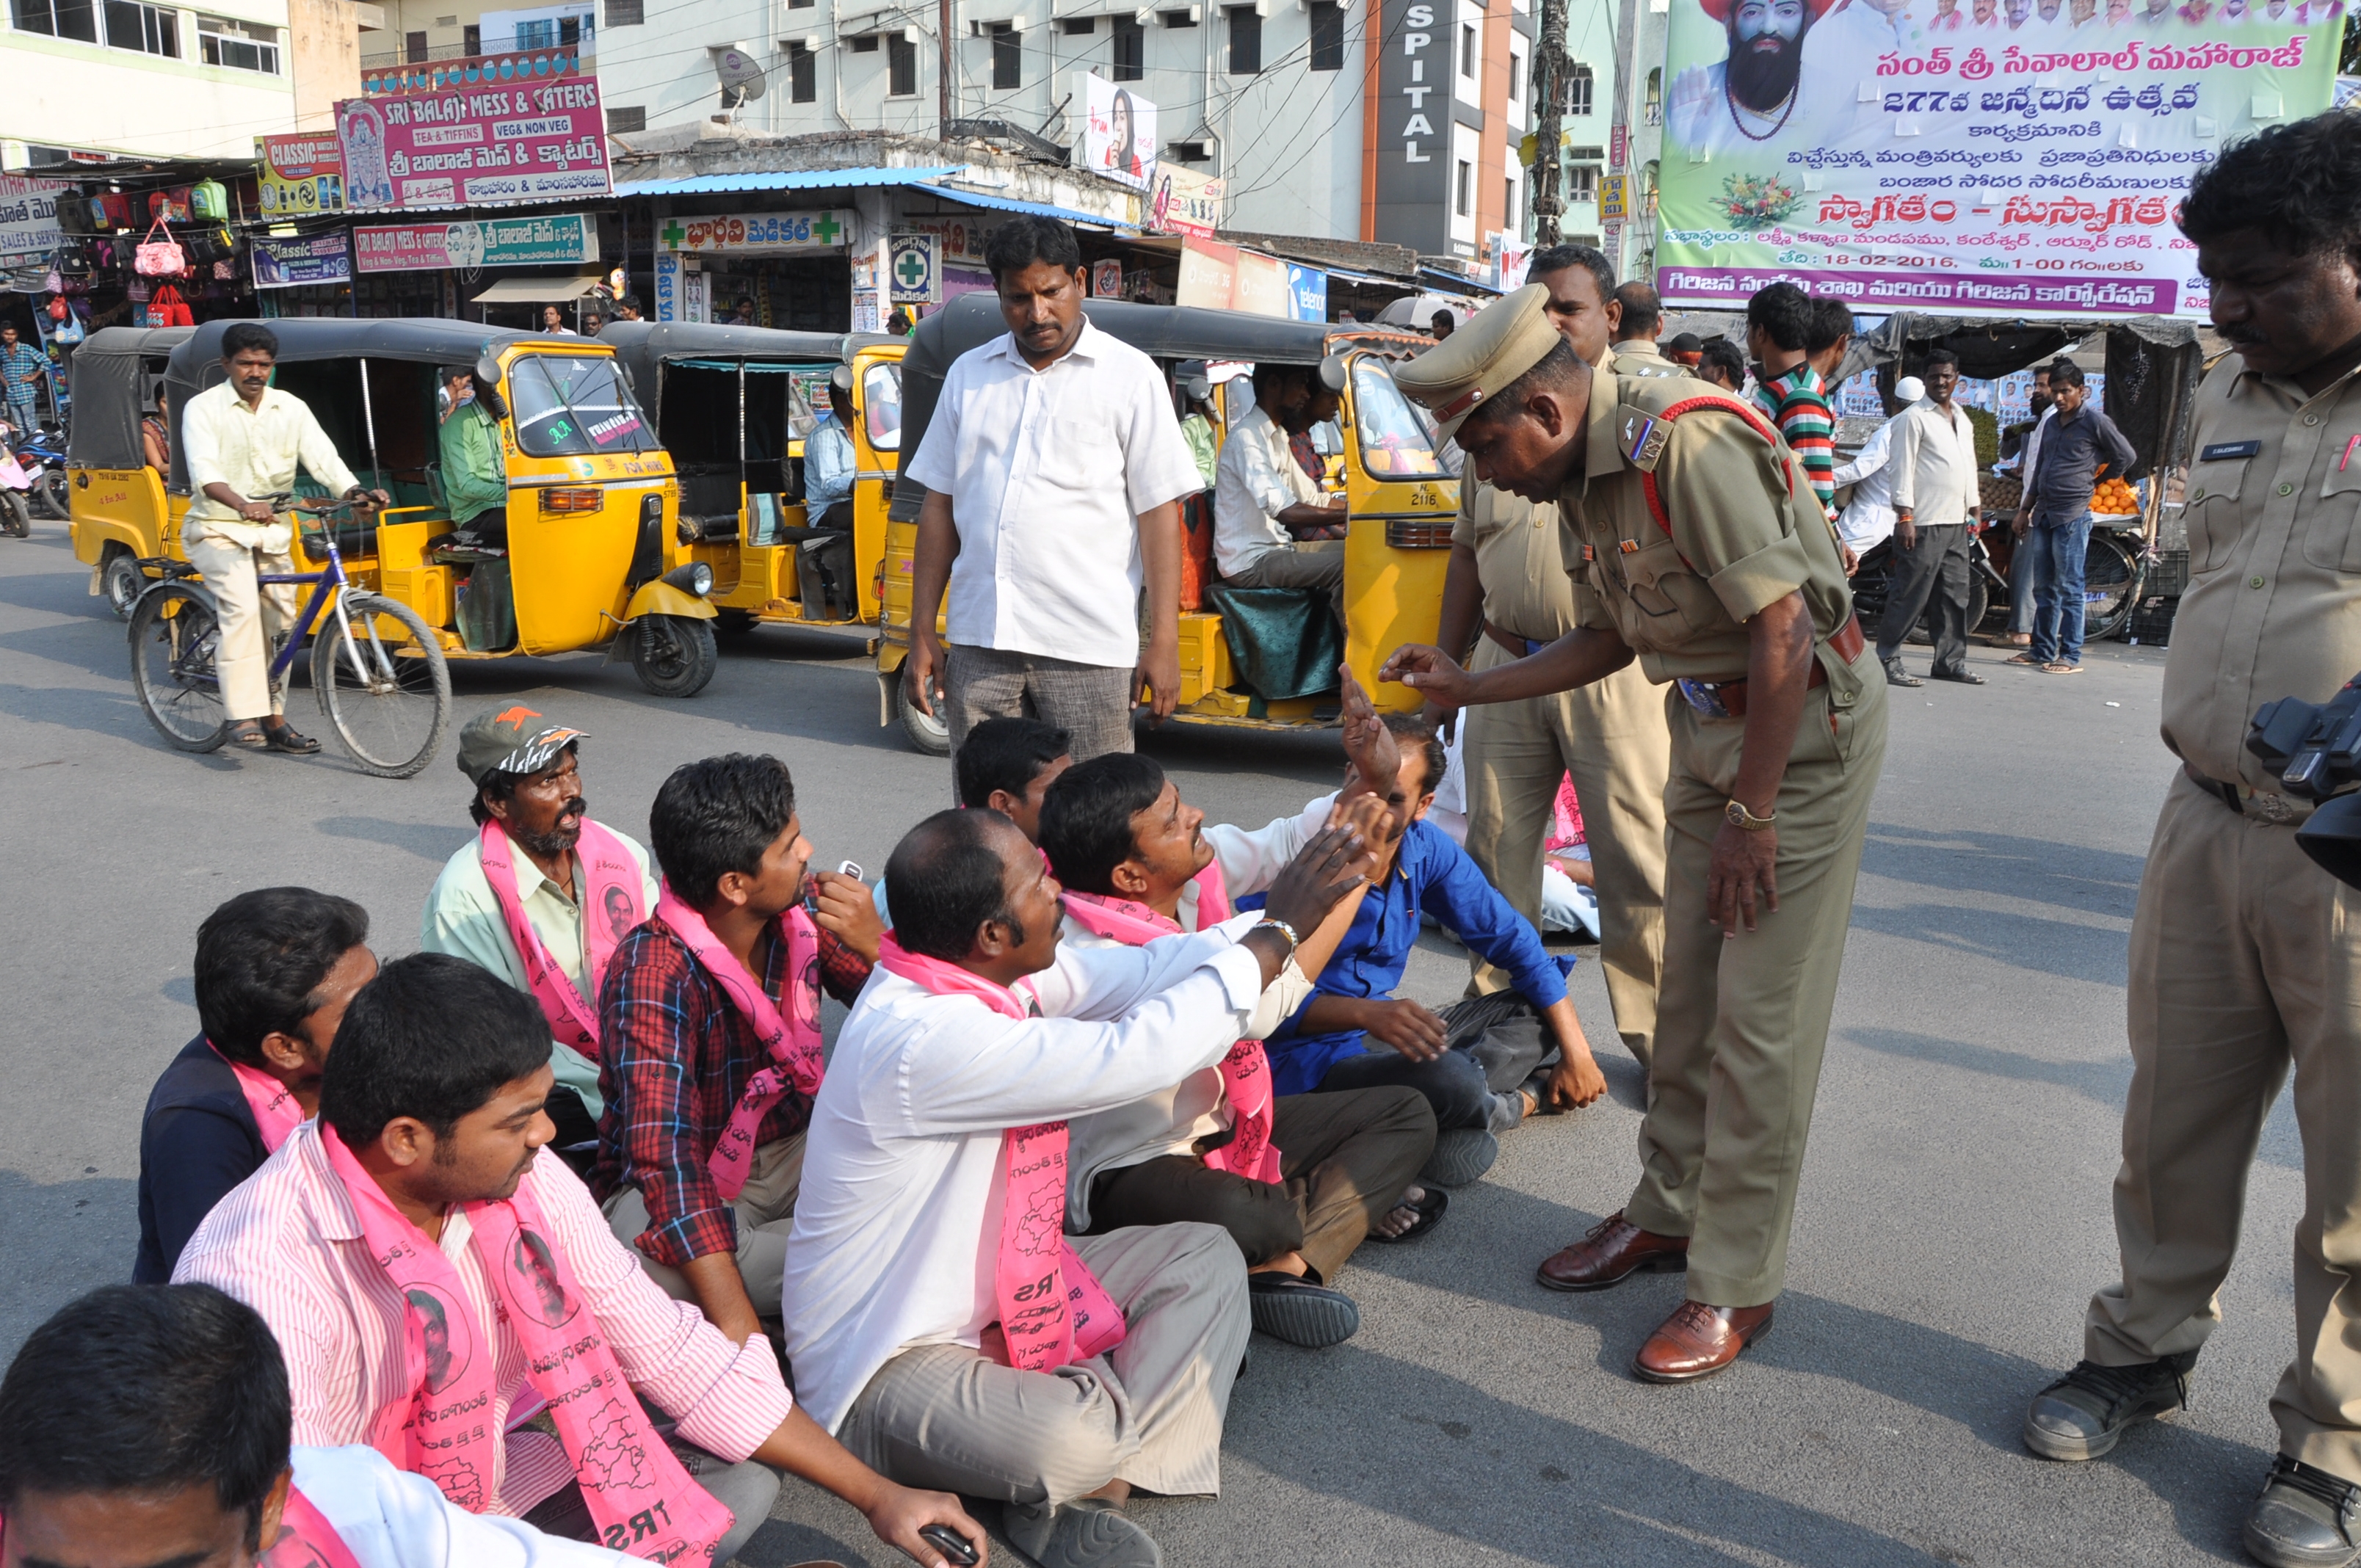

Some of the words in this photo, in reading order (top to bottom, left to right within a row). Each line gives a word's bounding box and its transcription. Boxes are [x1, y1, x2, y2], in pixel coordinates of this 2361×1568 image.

[1876, 47, 1954, 76] సంత్
[1959, 46, 1994, 81] శ్రీ
[2001, 41, 2144, 74] సేవాలాల్
[2147, 35, 2308, 71] మహారాజ్
[385, 102, 410, 126] SRI
[469, 92, 508, 117] MESS
[515, 91, 529, 114] &
[1980, 84, 2092, 119] జన్మదిన
[2102, 81, 2201, 117] ఉత్సవ
[416, 131, 432, 144] TEA
[435, 130, 442, 142] &
[444, 127, 479, 141] TIFFINS
[526, 120, 546, 134] NON
[548, 119, 569, 132] VEG
[1968, 121, 2102, 142] కార్యక్రమానికి
[271, 142, 317, 167] CLASSIC
[389, 150, 411, 178] శ్రీ
[412, 147, 474, 173] బాలాజీ
[476, 143, 511, 168] మెస్
[515, 142, 530, 164] &
[1875, 149, 2023, 169] మంత్రివర్యులకు
[521, 179, 530, 192] &
[1879, 173, 1954, 190] బంజార
[1959, 173, 2023, 190] సోదర
[415, 186, 424, 199] &
[1816, 192, 1958, 230] స్వాగతం
[1, 232, 27, 250] SALES
[29, 233, 35, 247] &
[358, 232, 370, 252] SRI
[397, 228, 416, 250] MESS
[417, 232, 422, 249] &
[485, 222, 497, 248] శ్రీ
[498, 222, 532, 244] బాలాజీ
[534, 219, 554, 243] మెస్
[686, 215, 745, 249] భార్గవి
[747, 217, 810, 244] మెడికల్
[1796, 231, 1849, 247] కళ్యాణ
[266, 242, 311, 262] Classic
[362, 256, 374, 267] Veg
[374, 257, 380, 266] &
[407, 255, 420, 264] Tea
[421, 255, 426, 264] &
[891, 290, 930, 302] మెడికల్
[1669, 272, 1736, 291] గిరిజన
[1815, 280, 1865, 298] శాఖ
[1868, 279, 1951, 300] మరియు
[1956, 280, 2031, 302] గిరిజన
[623, 462, 644, 476] FOR
[1411, 493, 1437, 506] 2116
